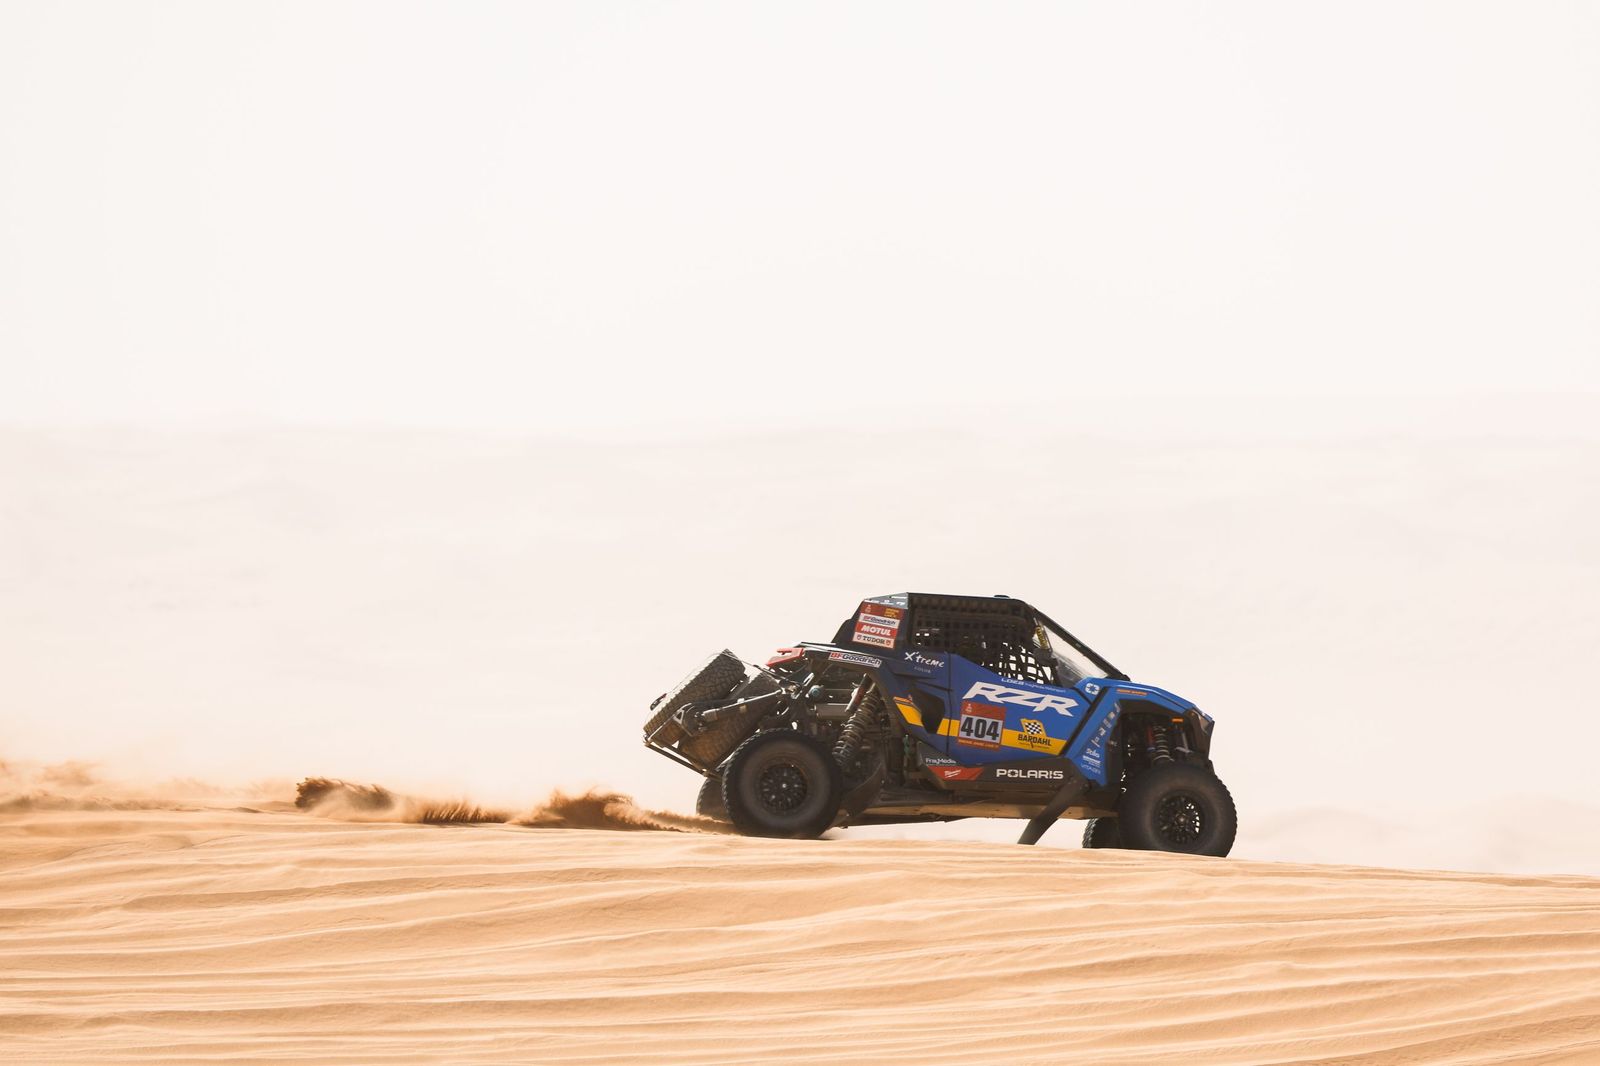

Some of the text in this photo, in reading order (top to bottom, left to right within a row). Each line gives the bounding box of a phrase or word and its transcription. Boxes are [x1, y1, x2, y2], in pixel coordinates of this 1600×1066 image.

[861, 624, 892, 636] MOTUL
[862, 635, 886, 645] TUDOR
[831, 652, 882, 666] BFGoodrich
[962, 681, 1079, 717] RZR
[961, 717, 1000, 741] 404
[1017, 733, 1052, 747] BARDAHL
[996, 768, 1064, 779] POLARIS
